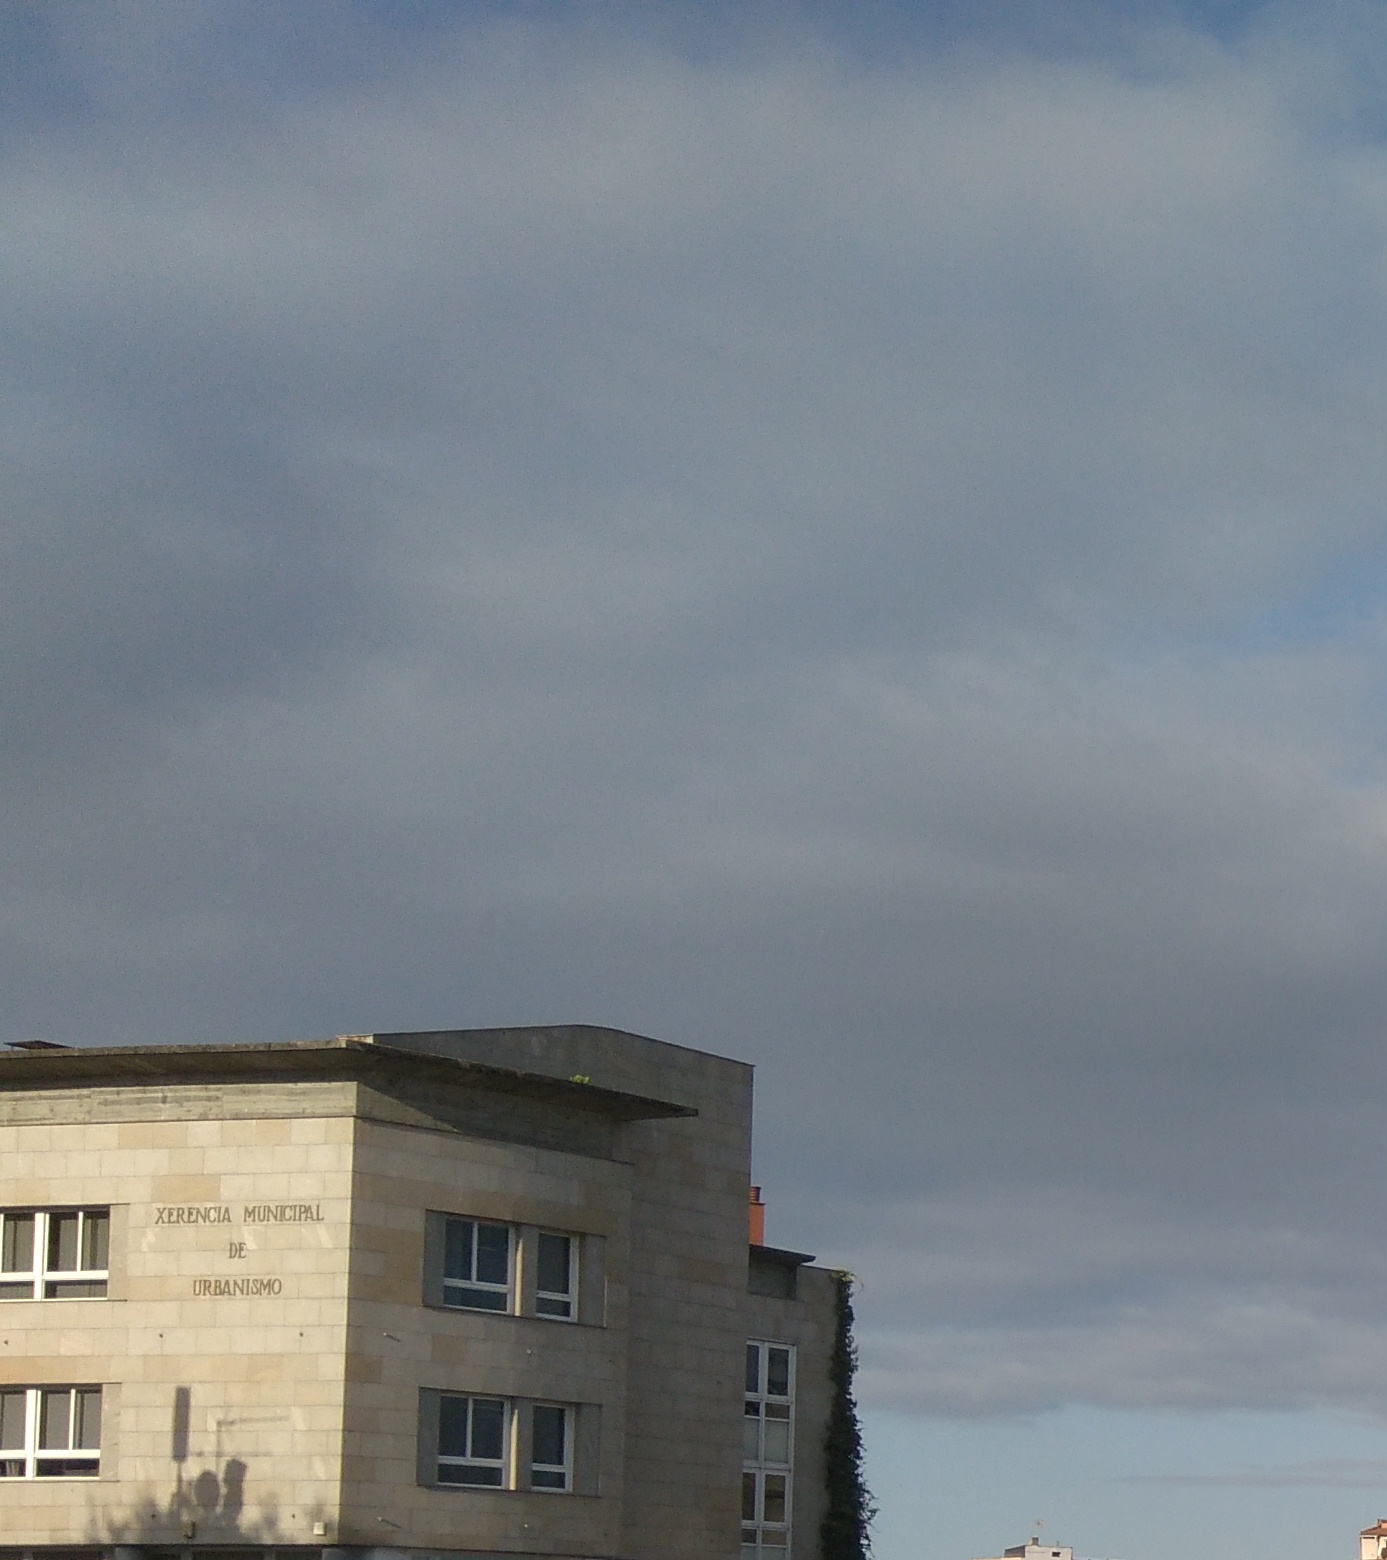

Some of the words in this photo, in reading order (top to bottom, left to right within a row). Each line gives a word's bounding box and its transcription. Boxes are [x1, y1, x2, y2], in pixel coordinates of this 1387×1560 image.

[155, 1205, 231, 1224] XERENCIA
[243, 1204, 325, 1223] MUNICIPAL
[228, 1242, 247, 1260] DE
[194, 1278, 282, 1297] URBANISMO
